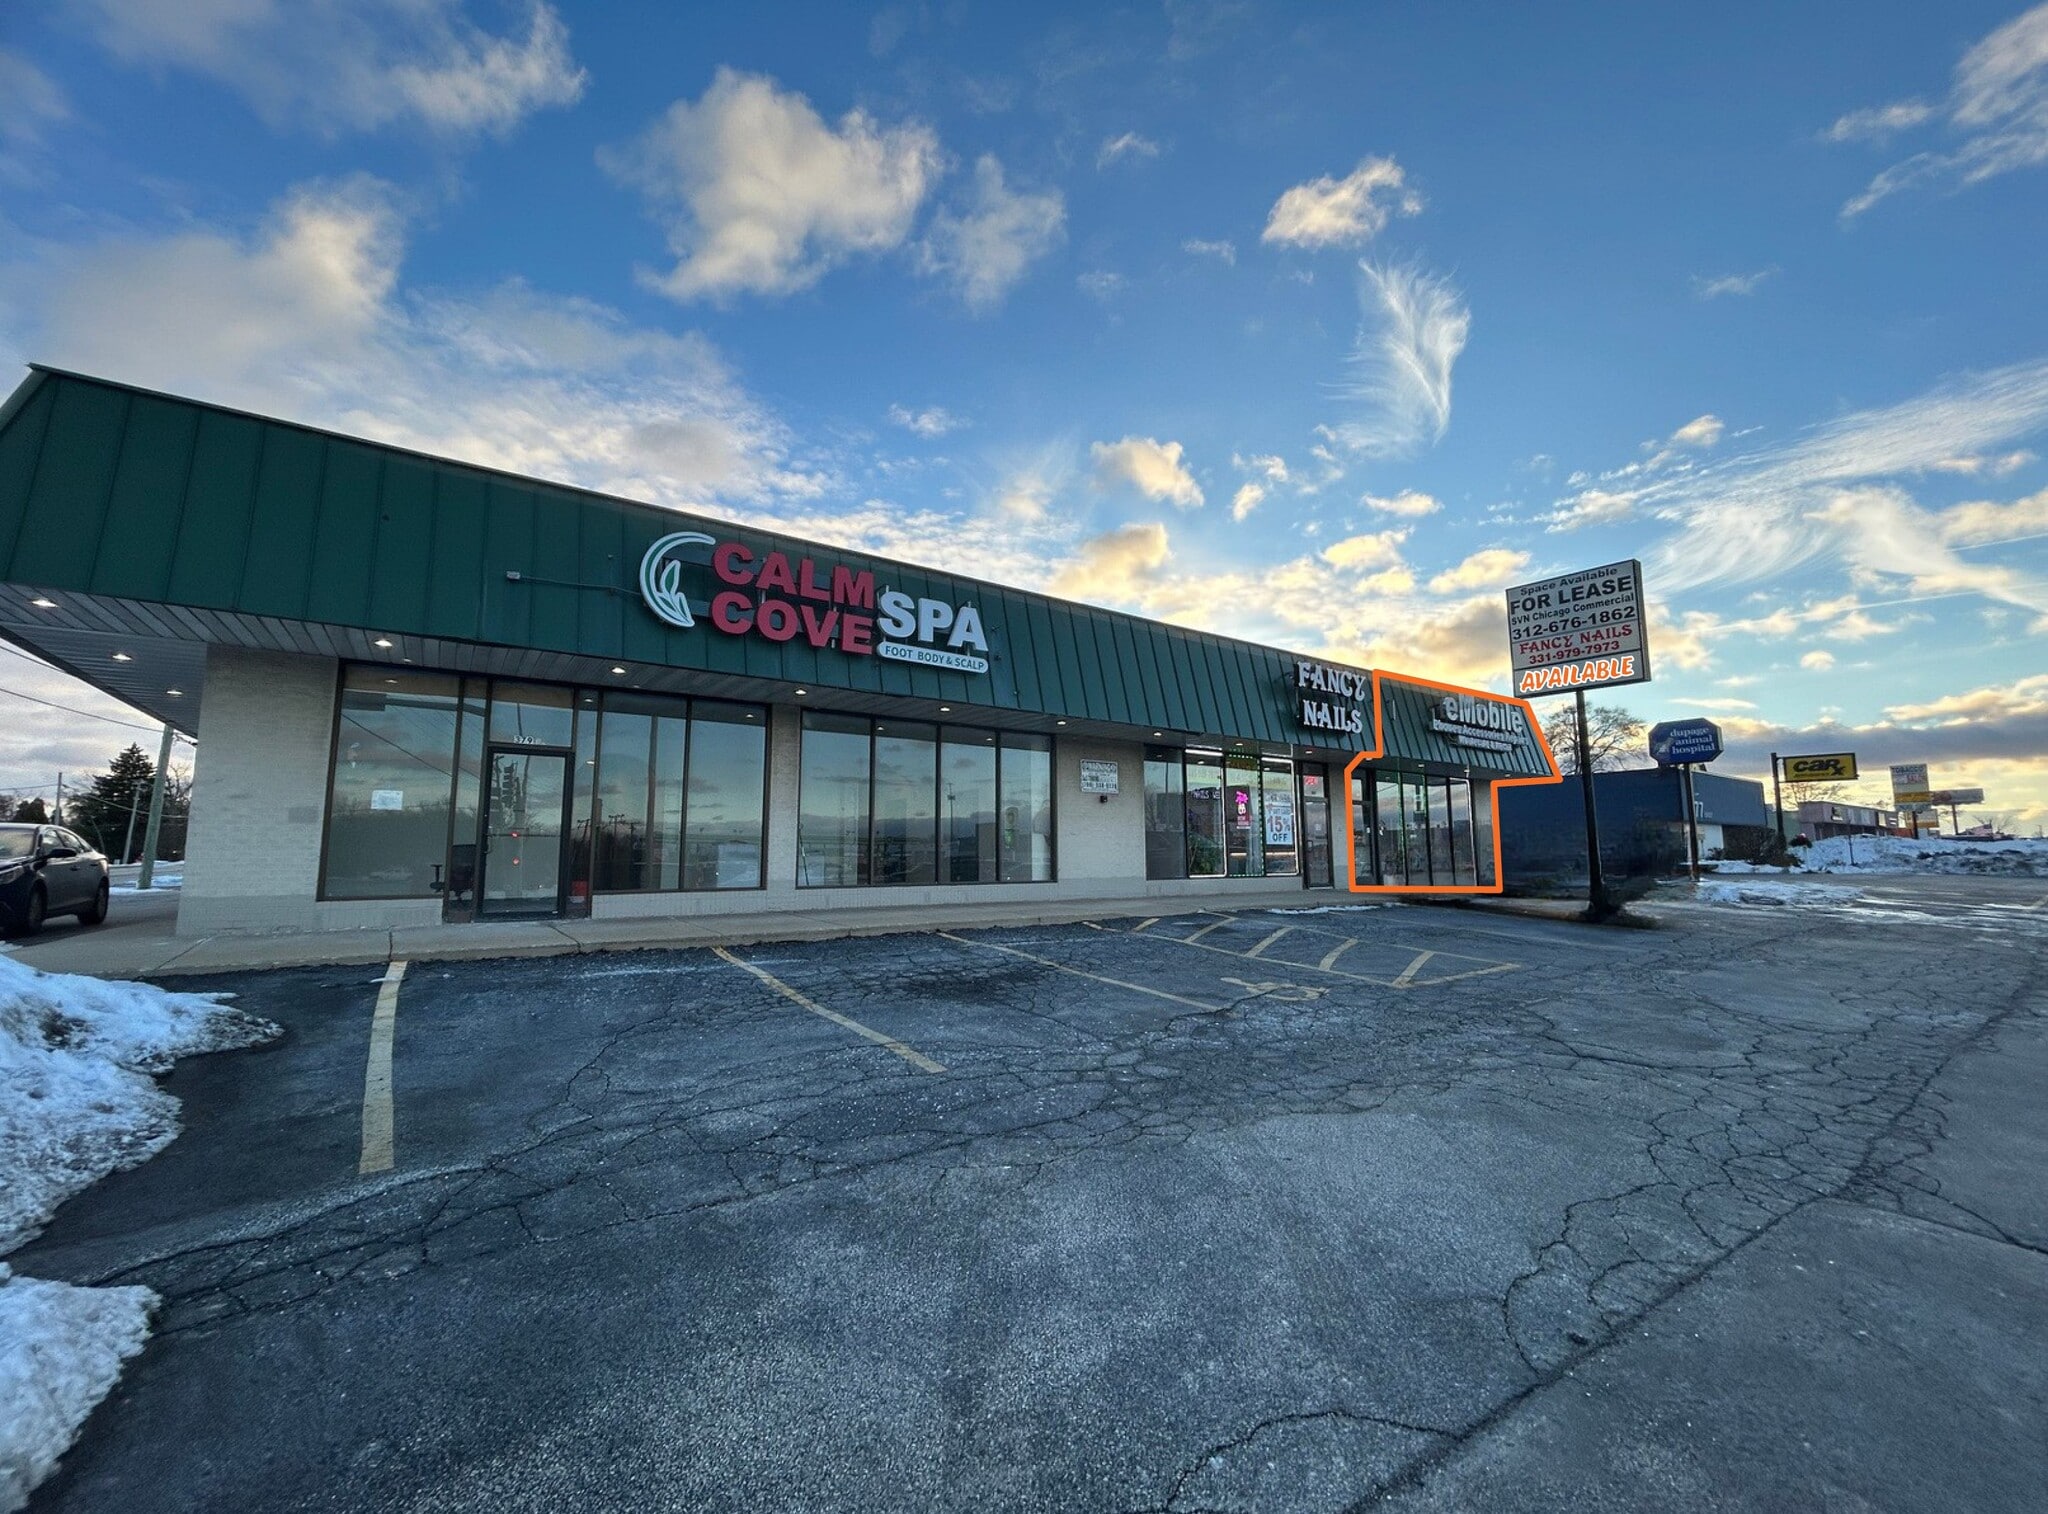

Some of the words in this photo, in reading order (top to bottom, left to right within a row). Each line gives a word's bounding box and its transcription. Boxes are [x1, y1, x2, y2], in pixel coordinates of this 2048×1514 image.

[713, 543, 874, 609] CALM
[1520, 582, 1556, 597] Space
[1560, 567, 1618, 587] Available
[1510, 593, 1551, 615] FOR
[1558, 575, 1632, 605] LEASE
[1511, 614, 1530, 626] SVN
[1532, 608, 1570, 621] Chicago
[1573, 592, 1634, 612] Commercial
[710, 591, 874, 655] COVE
[878, 590, 989, 651] SPA
[1513, 606, 1636, 640] 312-676-1862
[1519, 634, 1574, 654] FANCY
[1580, 624, 1633, 644] NAILS
[1529, 640, 1620, 665] 331-979-7973
[885, 645, 913, 658] FOOT
[917, 651, 945, 664] BODY
[946, 657, 952, 665] &
[954, 657, 985, 670] SCALP
[1298, 661, 1366, 702] FANCY
[1303, 700, 1363, 734] NAILS
[1443, 693, 1523, 733] eMobile
[1670, 728, 1709, 738] dupage
[1671, 743, 1715, 754] hospital
[1675, 734, 1713, 745] animal
[1272, 833, 1288, 842] OFF
